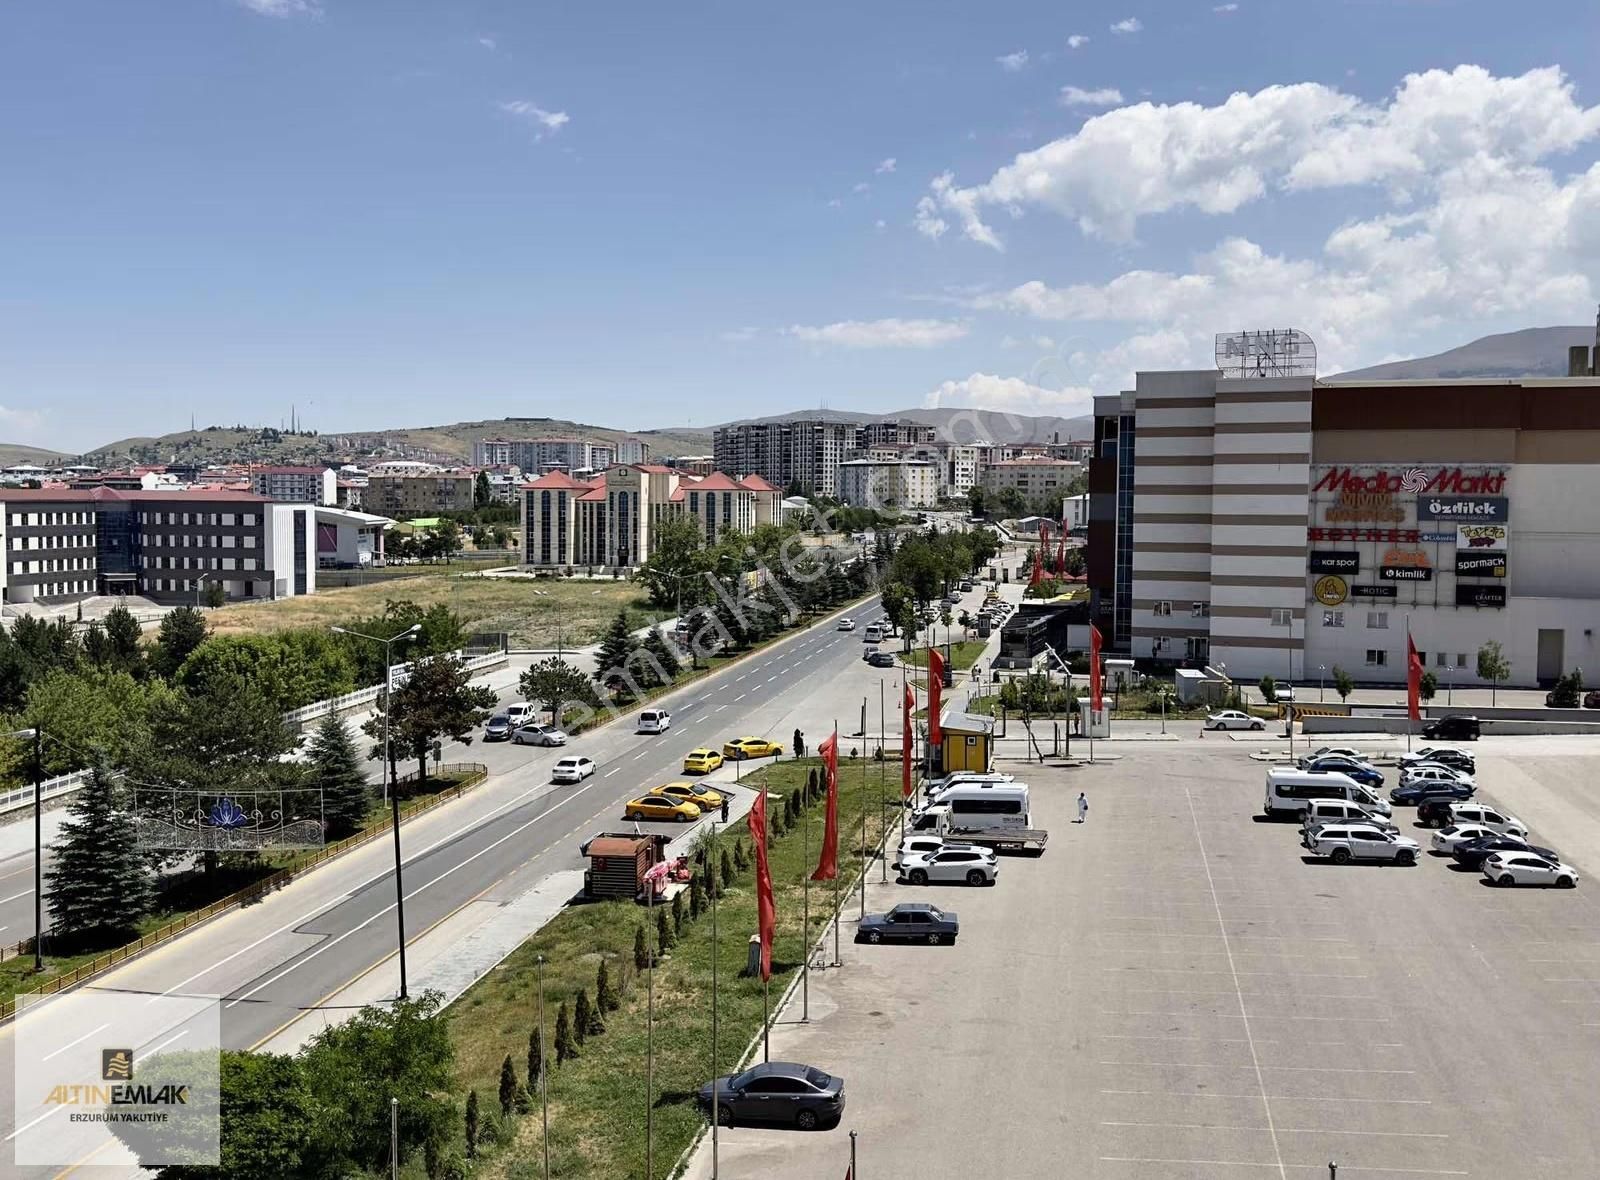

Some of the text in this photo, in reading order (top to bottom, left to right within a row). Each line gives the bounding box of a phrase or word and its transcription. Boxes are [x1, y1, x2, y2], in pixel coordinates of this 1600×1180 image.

[1313, 468, 1506, 493] Media Markt
[1429, 499, 1496, 514] Özdilek
[1458, 558, 1505, 570] spormack
[1395, 569, 1426, 580] kimlik
